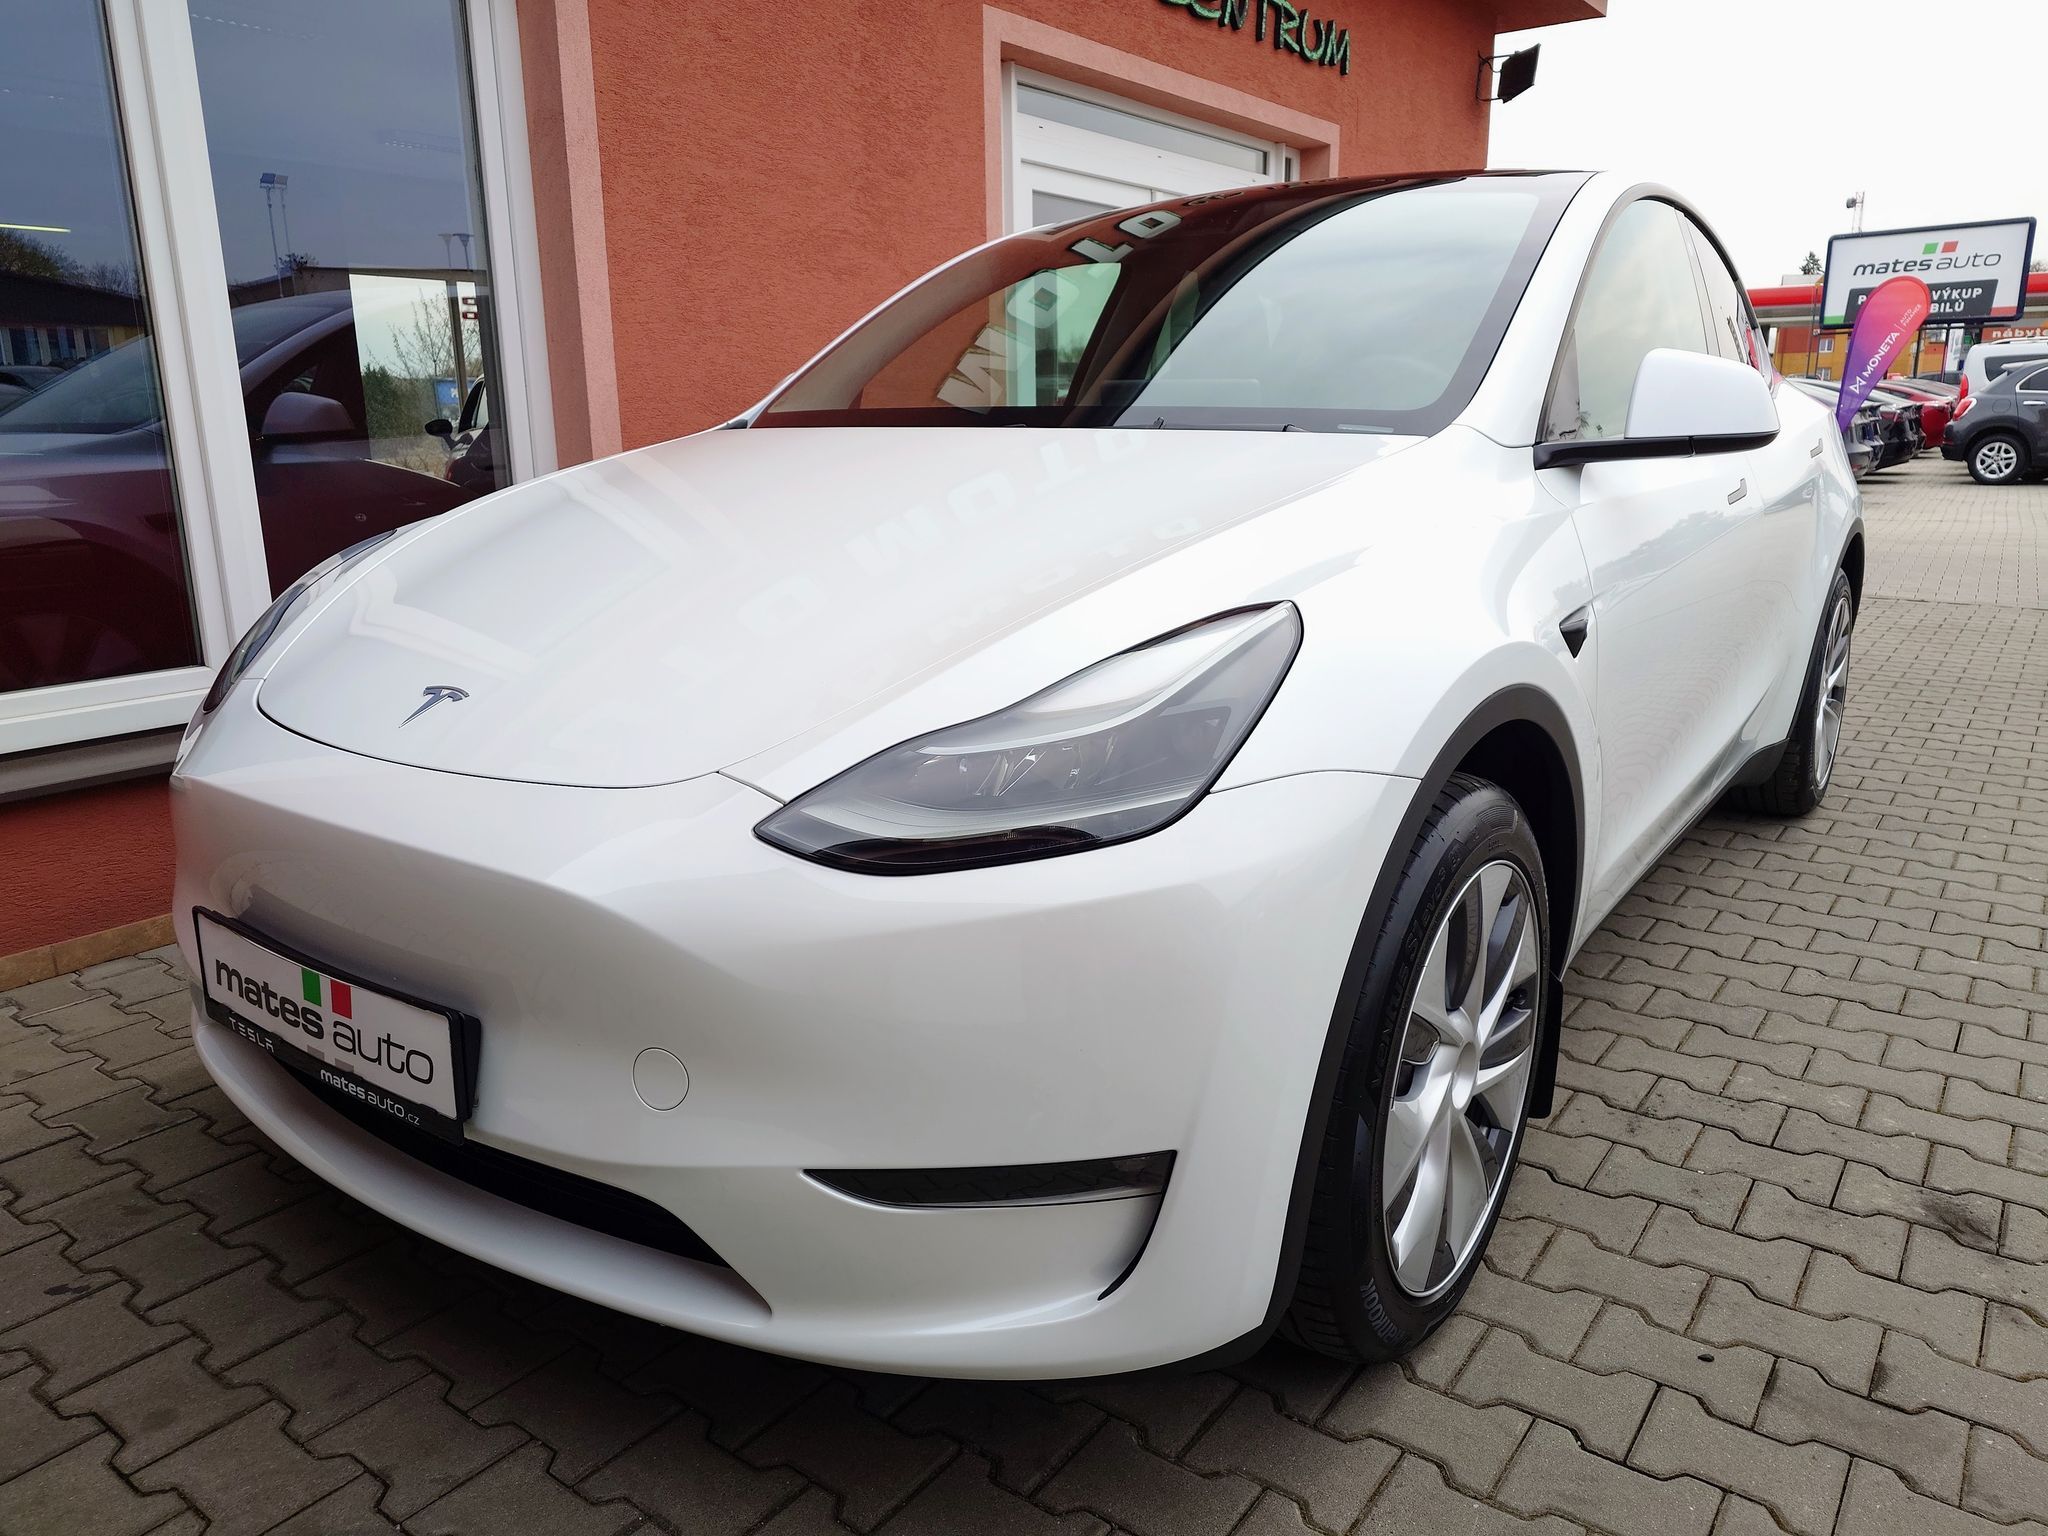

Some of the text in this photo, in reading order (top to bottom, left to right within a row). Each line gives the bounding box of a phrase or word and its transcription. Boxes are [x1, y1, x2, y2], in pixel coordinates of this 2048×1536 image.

[1160, 0, 1349, 75] NTRUM
[1852, 252, 2002, 276] mates auto
[1929, 299, 1965, 313] BILŮ
[1931, 287, 1983, 301] VÝKUP
[1862, 331, 1900, 378] MONETA
[215, 958, 434, 1085] mates auto
[229, 1016, 274, 1053] TESLA
